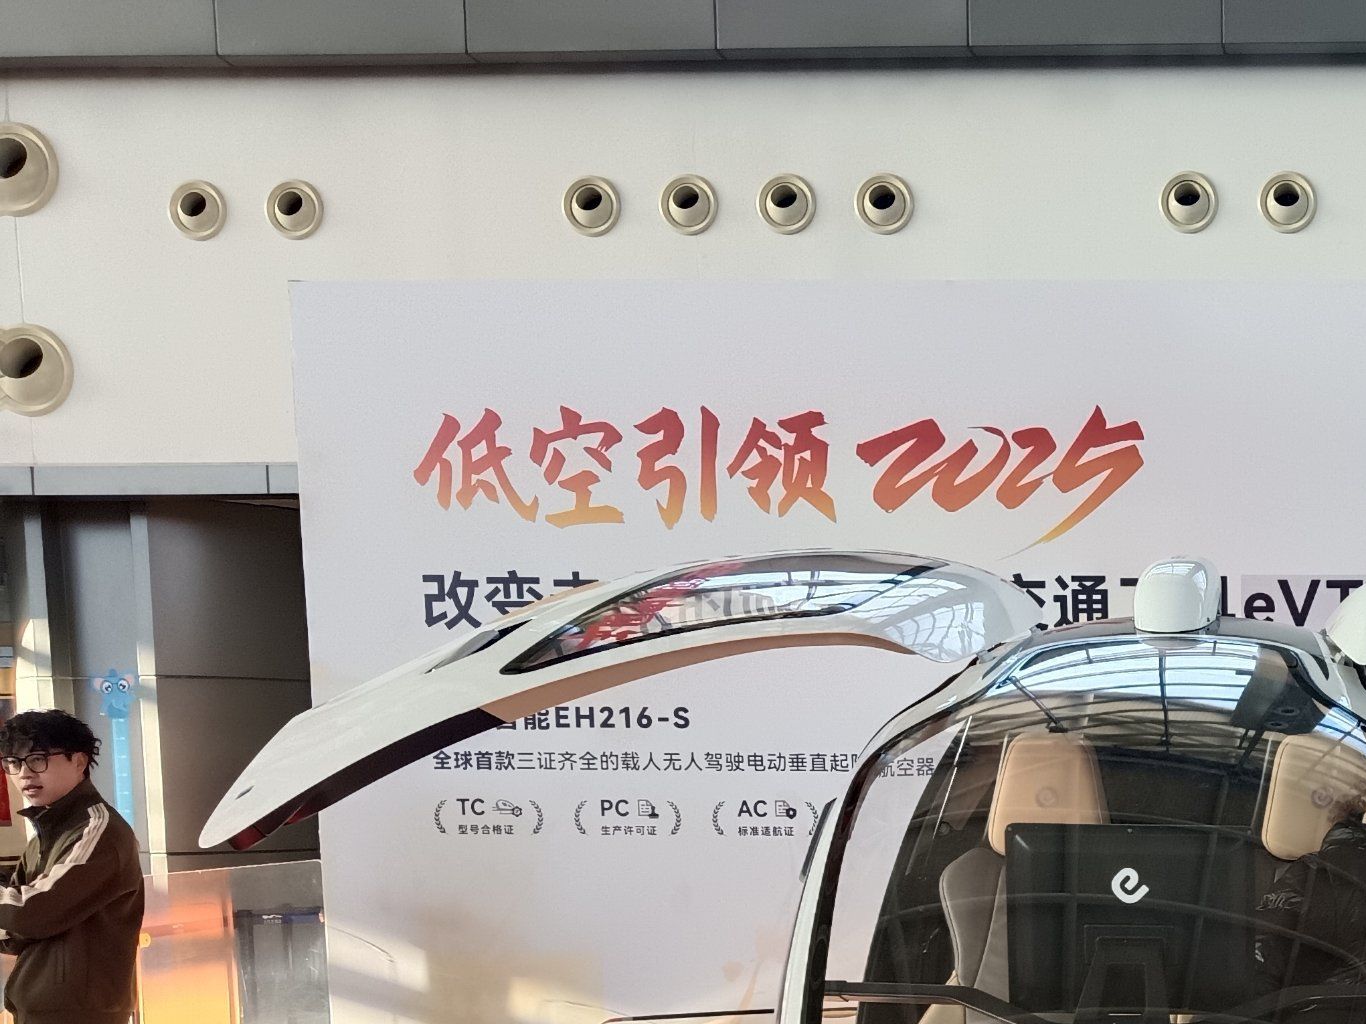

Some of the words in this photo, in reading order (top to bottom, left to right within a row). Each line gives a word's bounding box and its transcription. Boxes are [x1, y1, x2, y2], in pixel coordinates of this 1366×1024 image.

[413, 405, 838, 530] 低空引领
[856, 404, 1145, 559] 2025
[432, 750, 935, 779] 全球首款三证齐全的载人无人驾驶电动垂直起航空器
[456, 798, 486, 816] TC
[600, 799, 631, 817] PC
[737, 799, 768, 818] AC
[457, 824, 515, 836] 型号合格证
[600, 825, 658, 836] 生产许可证
[737, 825, 795, 837] 标准适航证
